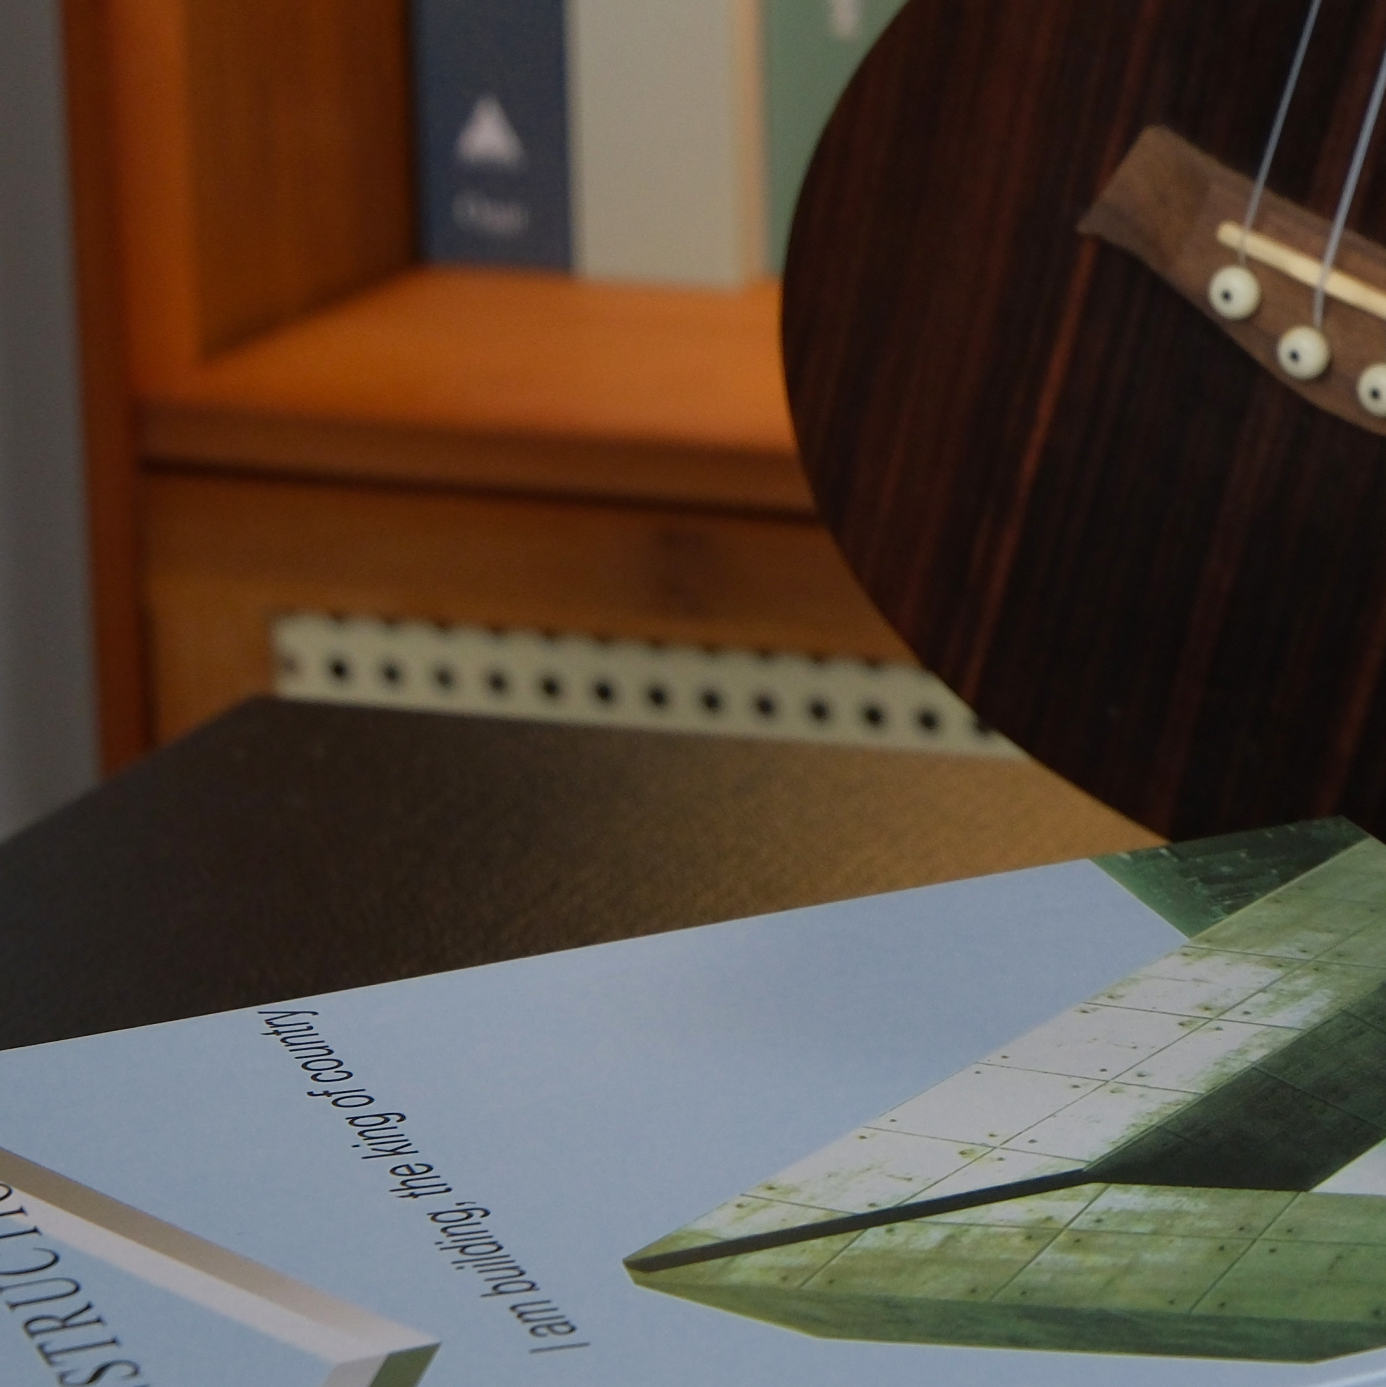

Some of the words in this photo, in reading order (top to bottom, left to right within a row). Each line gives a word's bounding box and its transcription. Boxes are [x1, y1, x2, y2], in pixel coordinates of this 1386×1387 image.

[256, 1010, 354, 1083] country
[306, 1088, 375, 1108] of
[345, 1112, 419, 1160] king
[389, 1163, 452, 1199] the
[426, 1201, 541, 1298] building,
[508, 1300, 578, 1338] am
[529, 1341, 591, 1354] I
